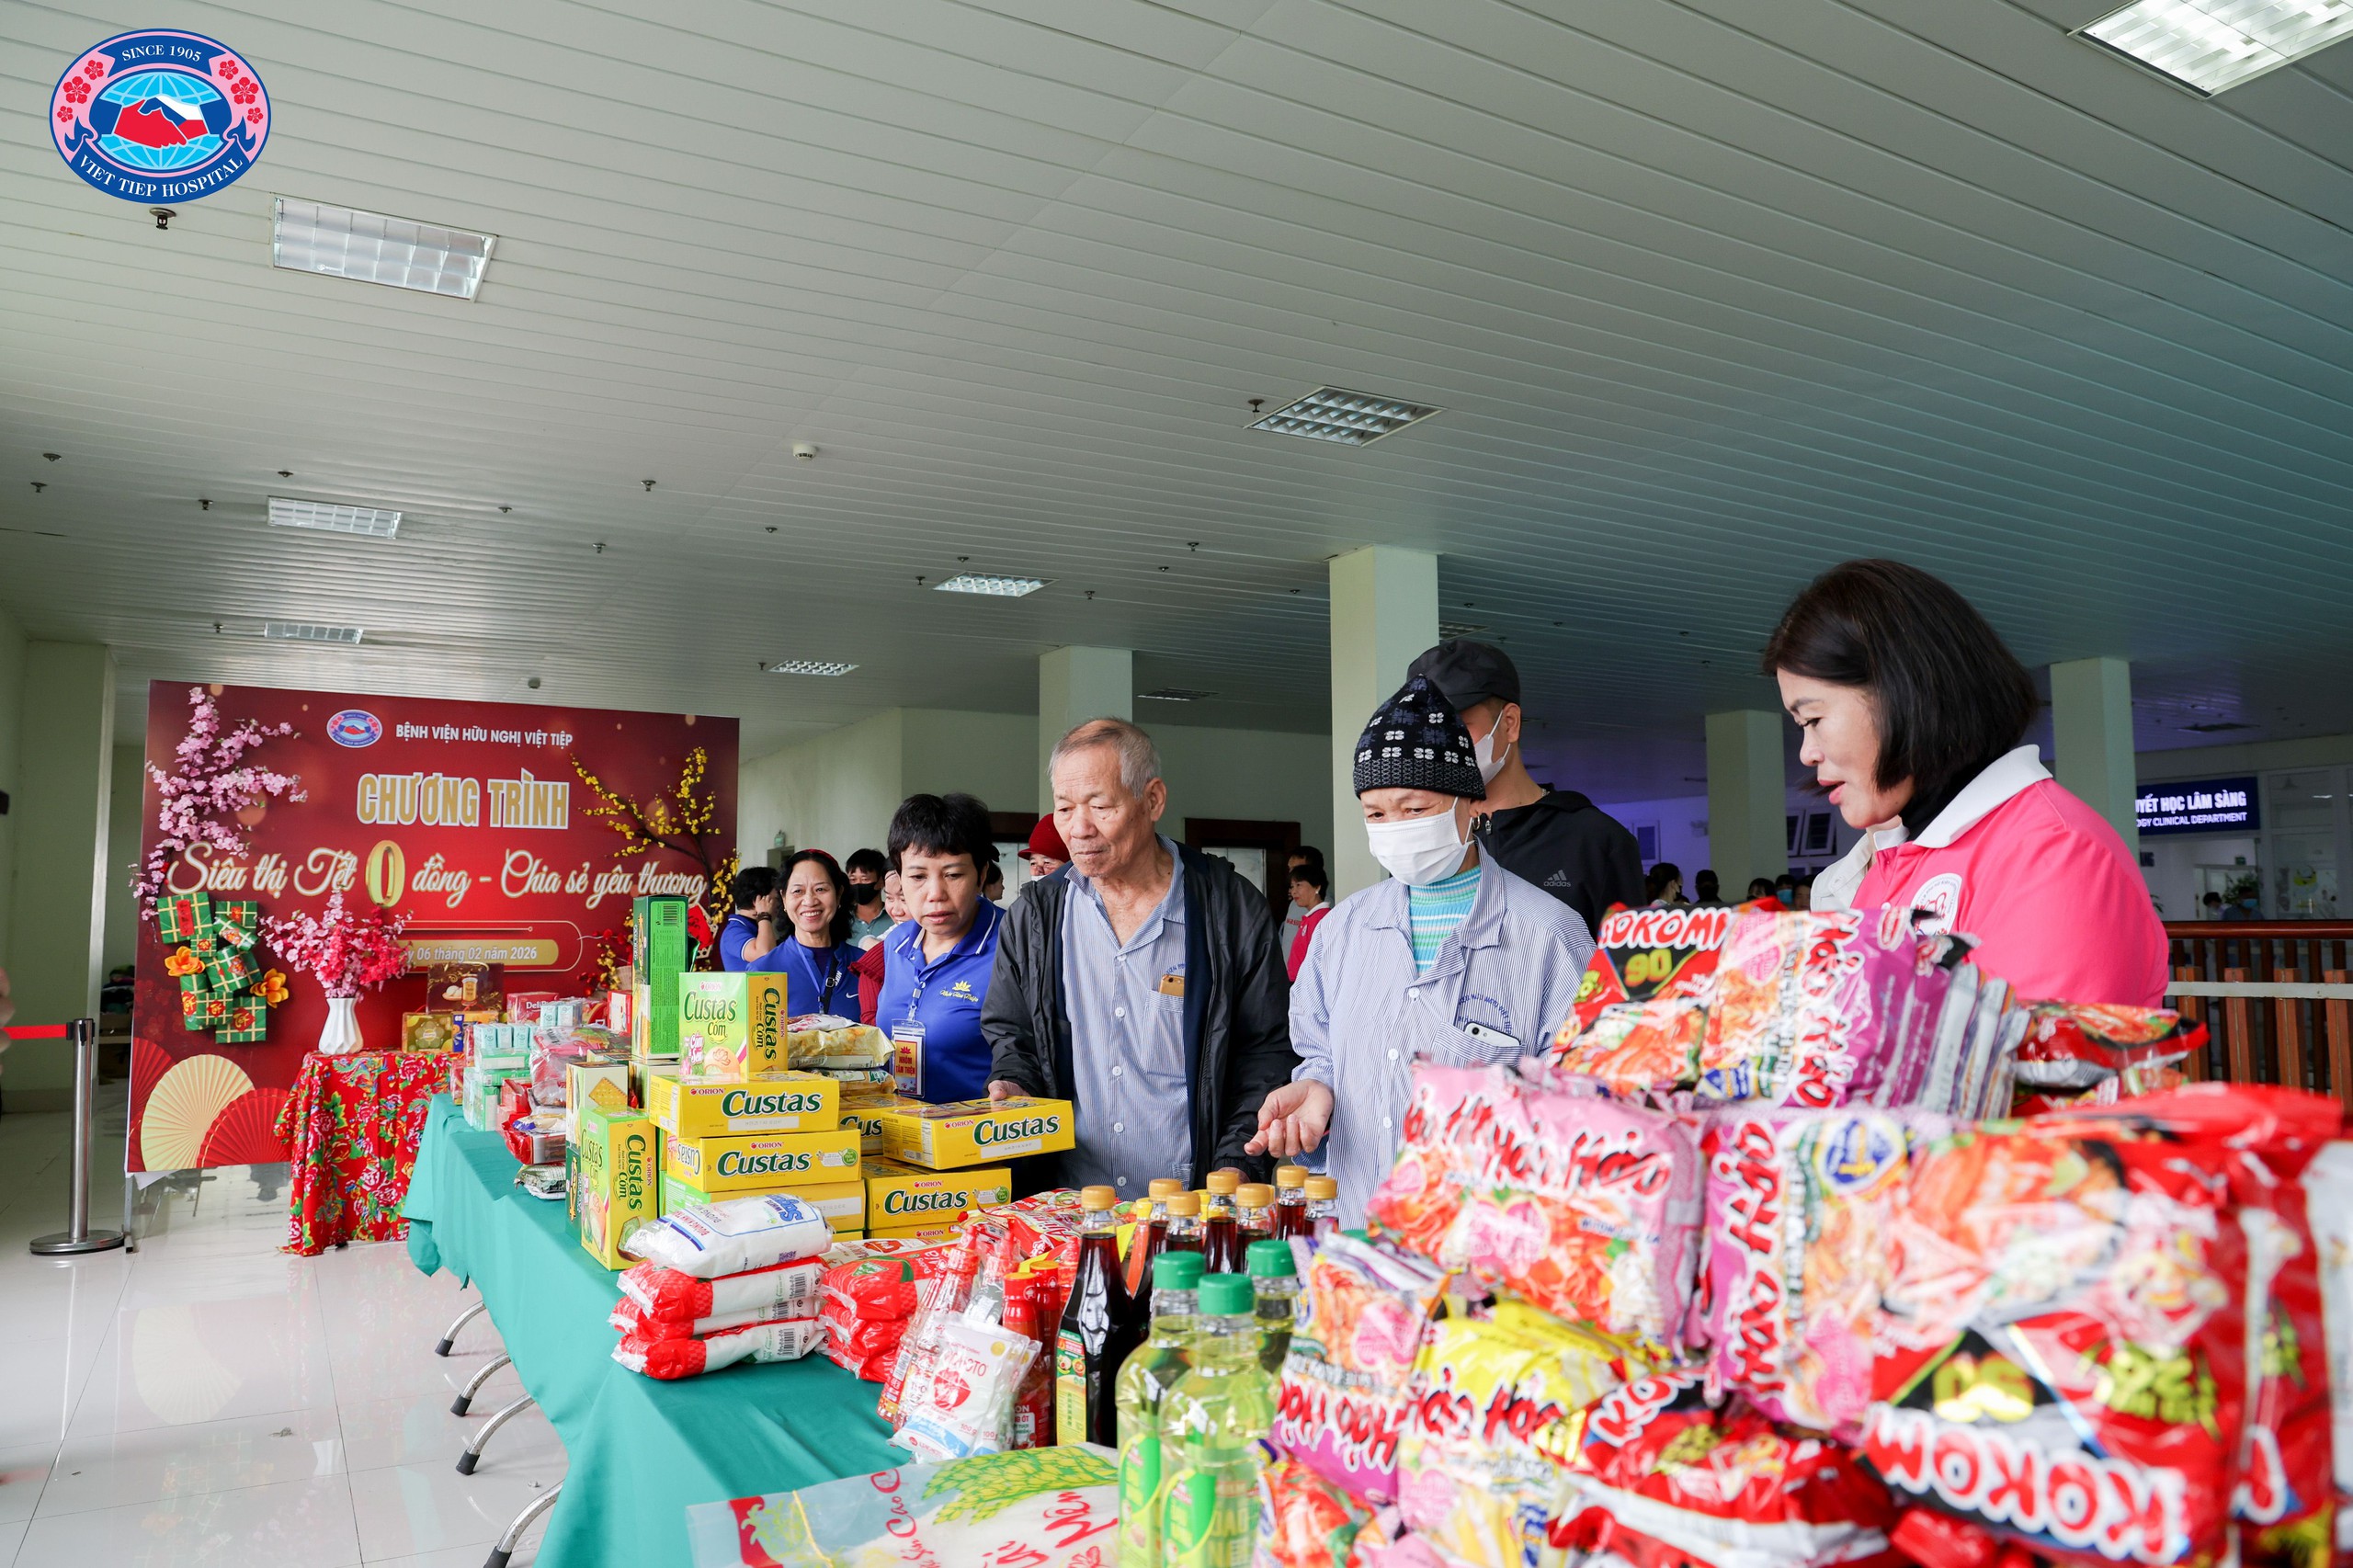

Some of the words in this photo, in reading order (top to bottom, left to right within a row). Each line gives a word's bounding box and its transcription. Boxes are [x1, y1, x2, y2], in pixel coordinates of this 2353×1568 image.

[395, 721, 428, 742] BỆNH
[431, 723, 460, 744] VIỆN
[461, 724, 488, 743] HỮU
[490, 730, 521, 747] NGHỊ
[524, 729, 548, 749] VIỆT
[551, 731, 574, 750] TIỆP
[357, 772, 481, 827] CHƯƠNG
[487, 767, 570, 829] TRÌNH
[2160, 796, 2186, 814] HỌC
[2187, 791, 2213, 810] LÂM
[2214, 789, 2247, 809] SÀNG
[2152, 815, 2190, 827] CLINICAL
[2190, 812, 2247, 824] DEPARTMENT
[166, 841, 248, 896] Siêu
[252, 853, 289, 899] thị
[293, 846, 359, 897] Tết
[365, 840, 406, 908] 0
[411, 852, 472, 909] đồng
[500, 848, 562, 898] Chia
[564, 861, 589, 894] sẻ
[593, 865, 634, 911] yêu
[637, 860, 709, 903] thương
[1543, 877, 1572, 888] adidas
[416, 948, 431, 960] 06
[434, 946, 465, 963] tháng
[468, 948, 483, 960] 02
[484, 948, 507, 960] năm
[510, 947, 538, 960] 2026
[1624, 948, 1673, 987] 90
[684, 991, 737, 1022] Custas
[764, 987, 780, 1061] Custas
[697, 1087, 726, 1096] ORION
[722, 1089, 824, 1118] Custas
[950, 1119, 975, 1129] ORION
[973, 1115, 1061, 1147] Custas
[627, 1134, 647, 1212] Custas
[717, 1150, 812, 1177] Custas
[919, 1180, 943, 1188] ORION
[884, 1188, 968, 1215] Custas
[922, 1229, 944, 1237] ORION
[1864, 1402, 2191, 1566] KOKOM
